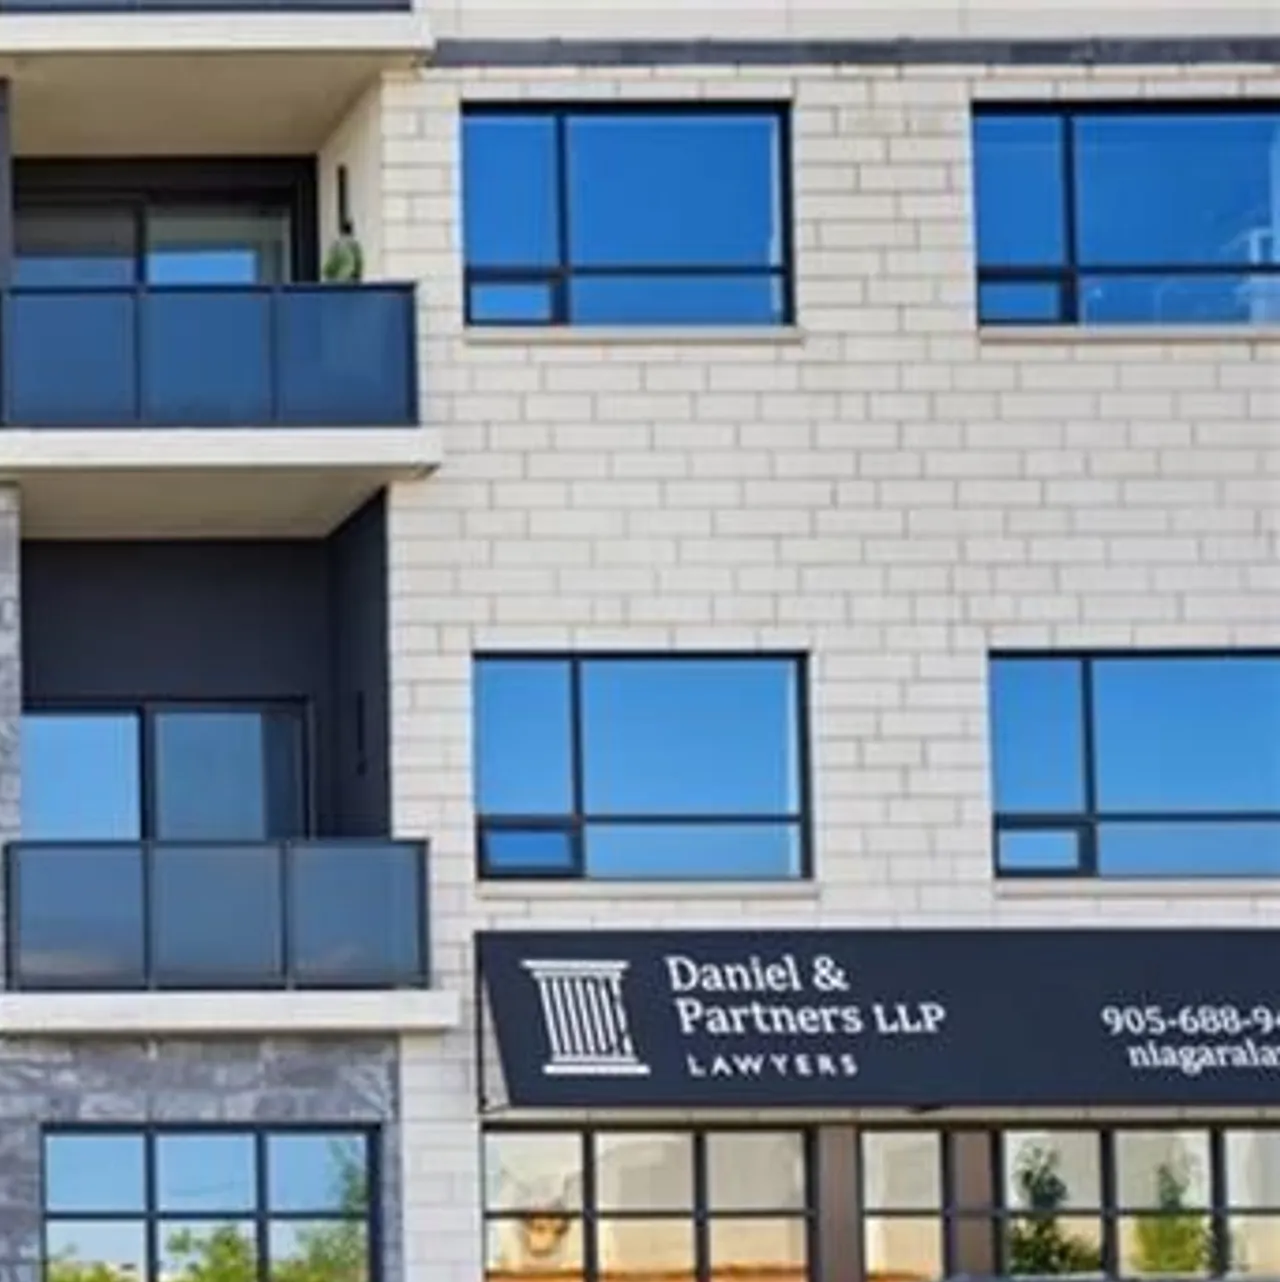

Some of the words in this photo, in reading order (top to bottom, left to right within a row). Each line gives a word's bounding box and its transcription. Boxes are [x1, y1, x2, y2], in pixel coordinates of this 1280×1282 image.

[665, 954, 803, 993] Daniel
[811, 955, 850, 992] &
[675, 997, 865, 1036] Partners
[872, 1003, 947, 1034] LLP
[1100, 1004, 1280, 1035] 905-688-9
[687, 1053, 859, 1077] LAWYERS
[1126, 1038, 1280, 1076] niagarala
